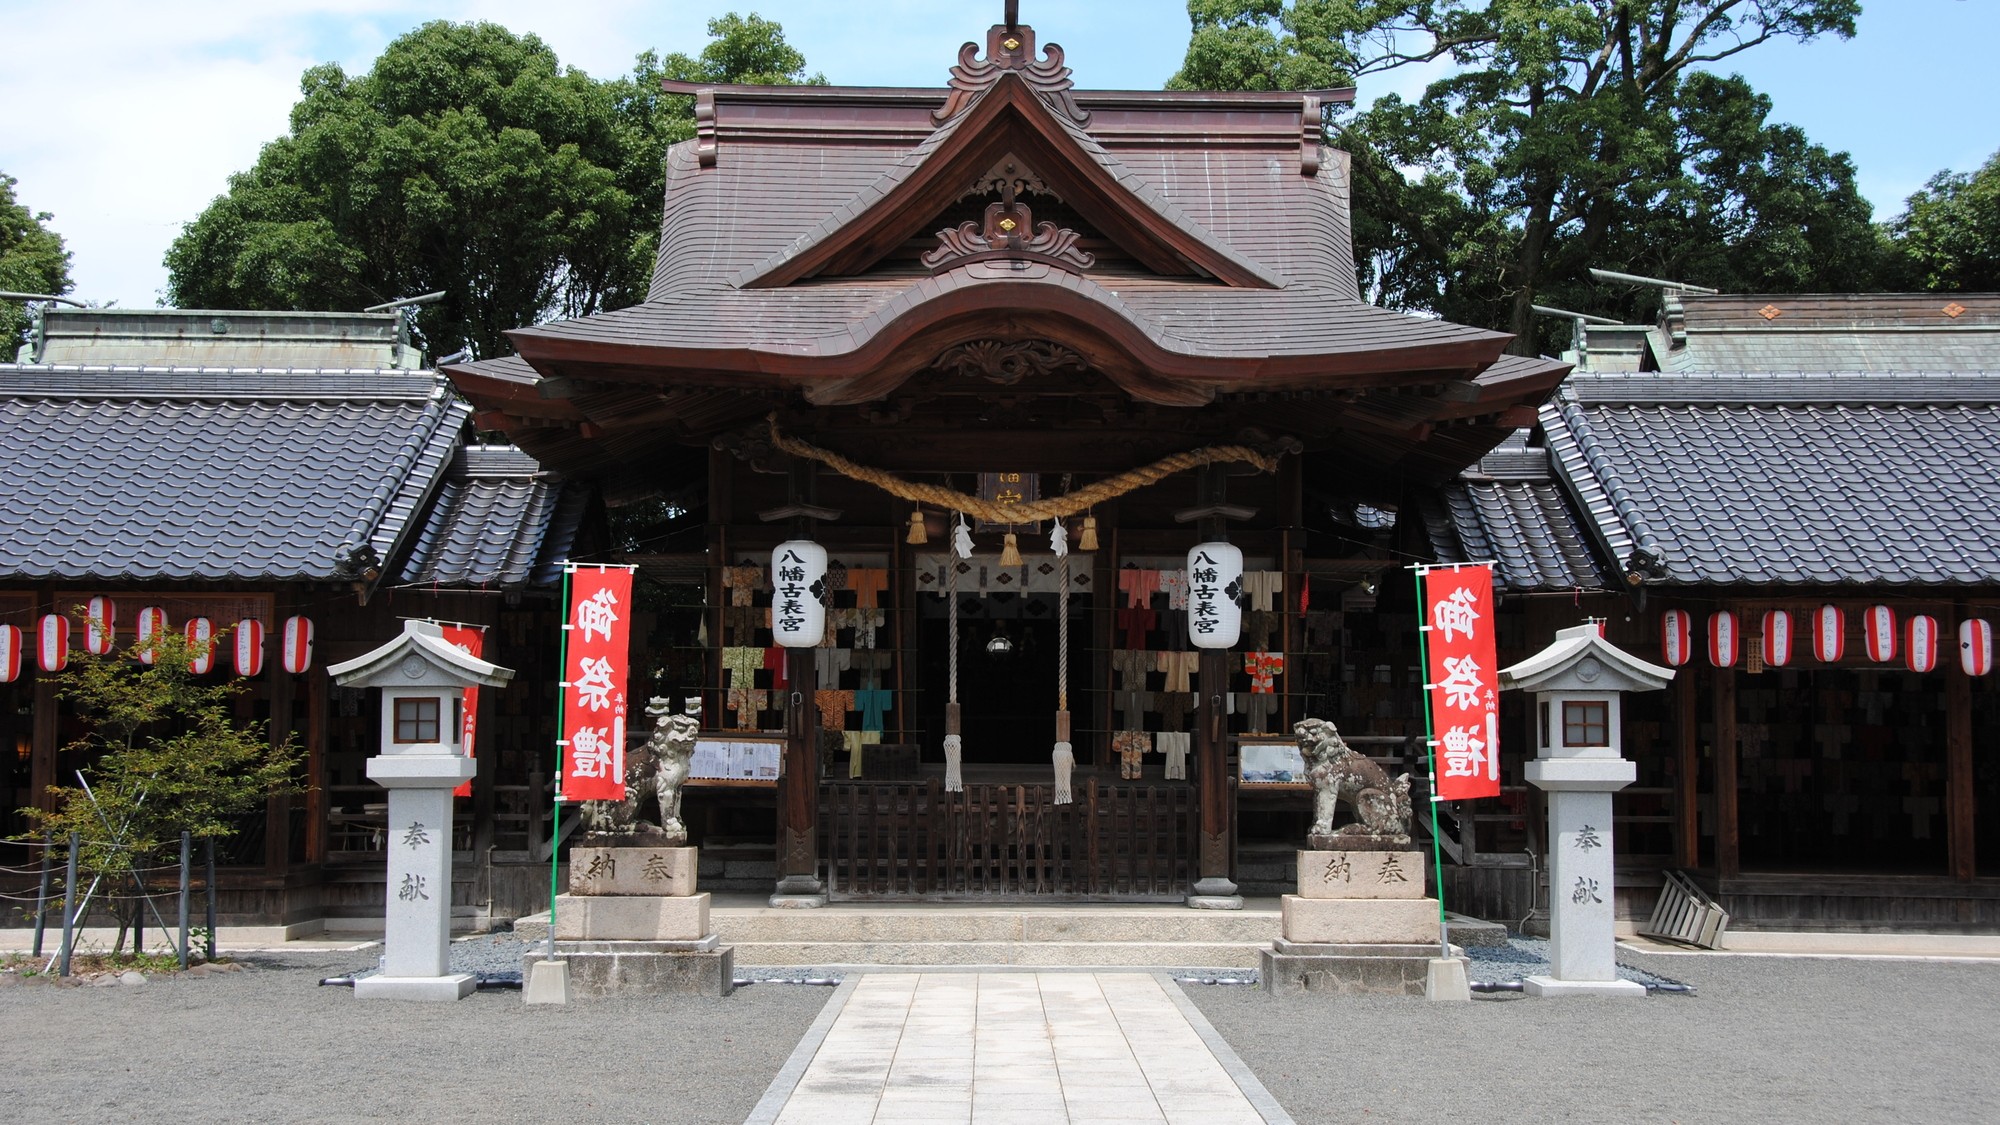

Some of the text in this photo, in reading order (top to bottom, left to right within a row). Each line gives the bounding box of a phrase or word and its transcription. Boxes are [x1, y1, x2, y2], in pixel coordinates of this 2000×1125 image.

[779, 549, 806, 632] 八幡古表宮
[1193, 551, 1219, 633] 八幡古表宮
[399, 822, 430, 901] 奉献
[1572, 824, 1602, 904] 奉献
